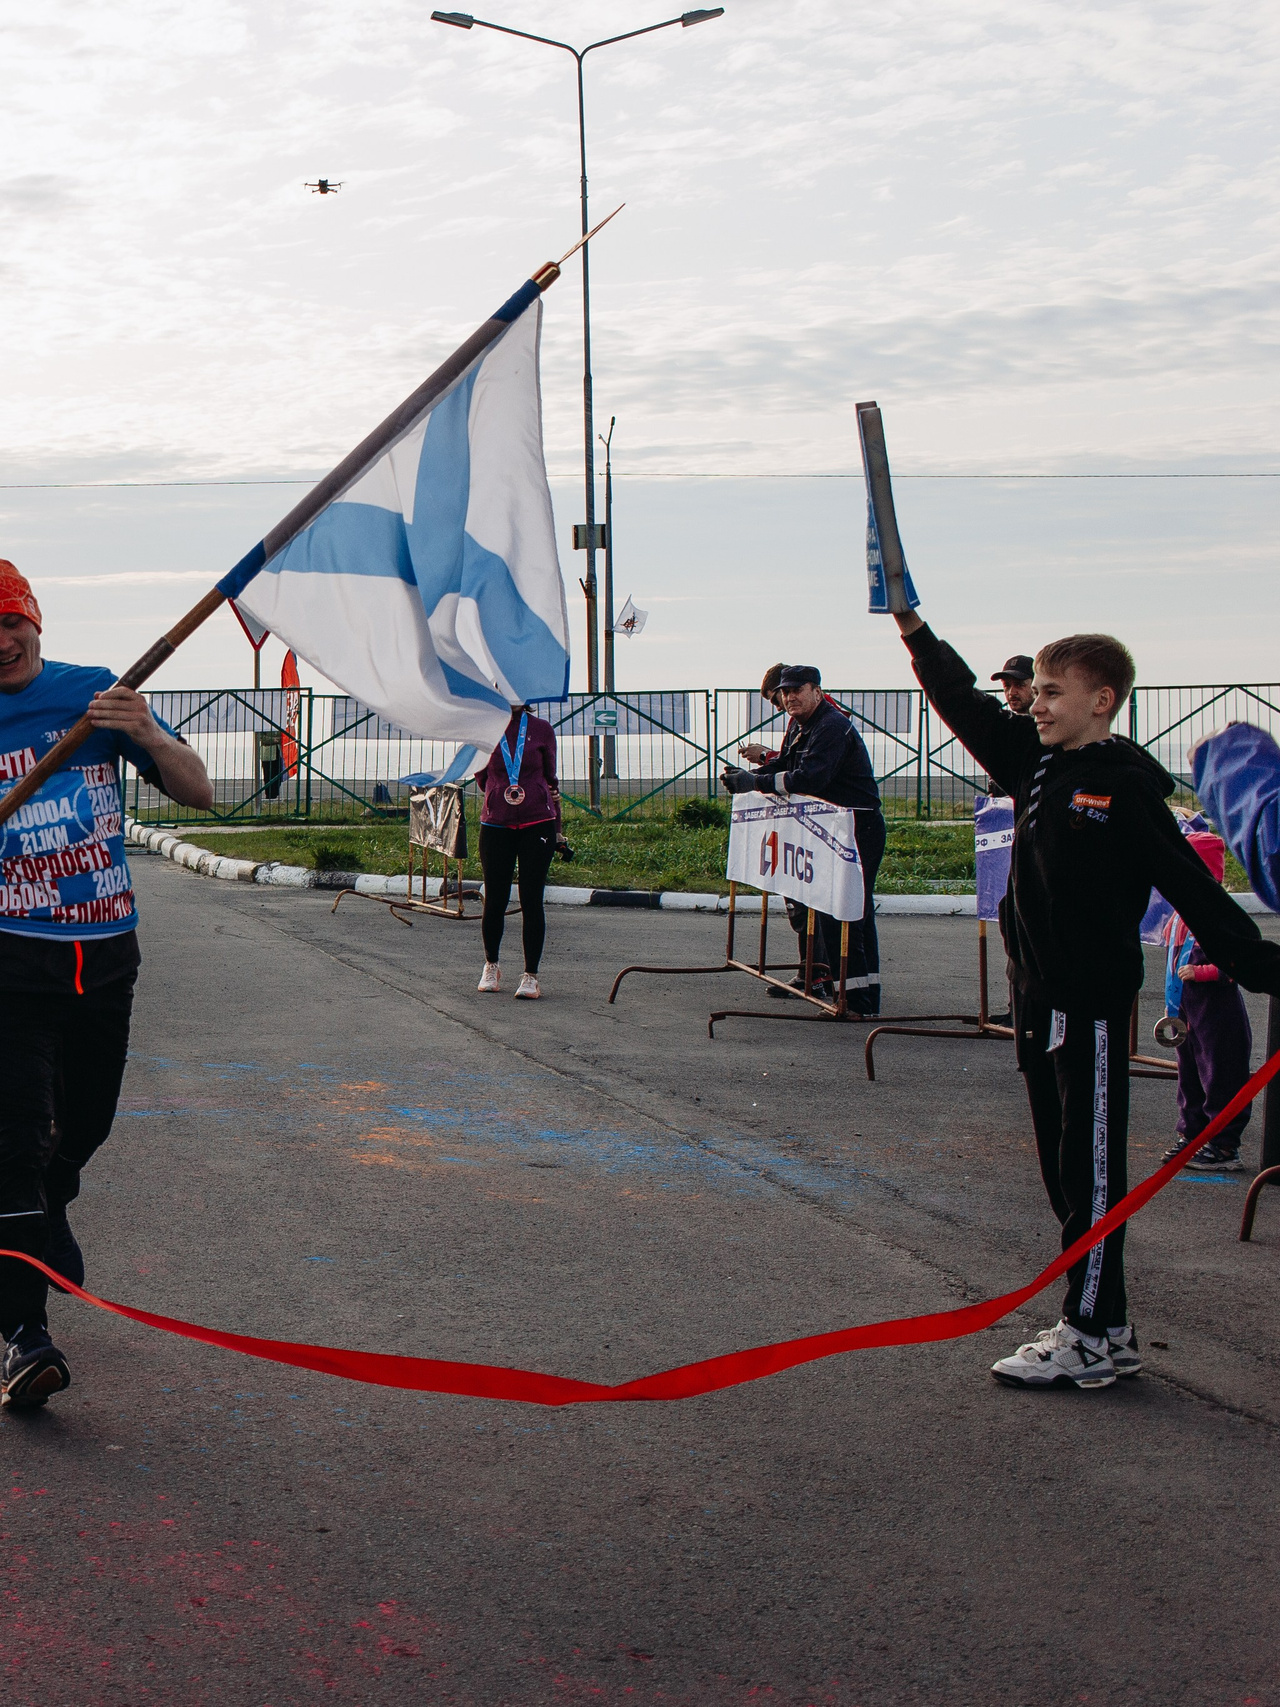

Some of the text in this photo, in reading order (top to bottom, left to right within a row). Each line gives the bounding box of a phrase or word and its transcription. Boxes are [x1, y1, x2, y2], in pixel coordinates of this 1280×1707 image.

[7, 797, 75, 831] 40004
[87, 784, 120, 817] 2024
[2, 842, 113, 886] #ГОРДОСТЬ
[783, 841, 814, 884] ПСБ
[92, 863, 128, 899] 2024
